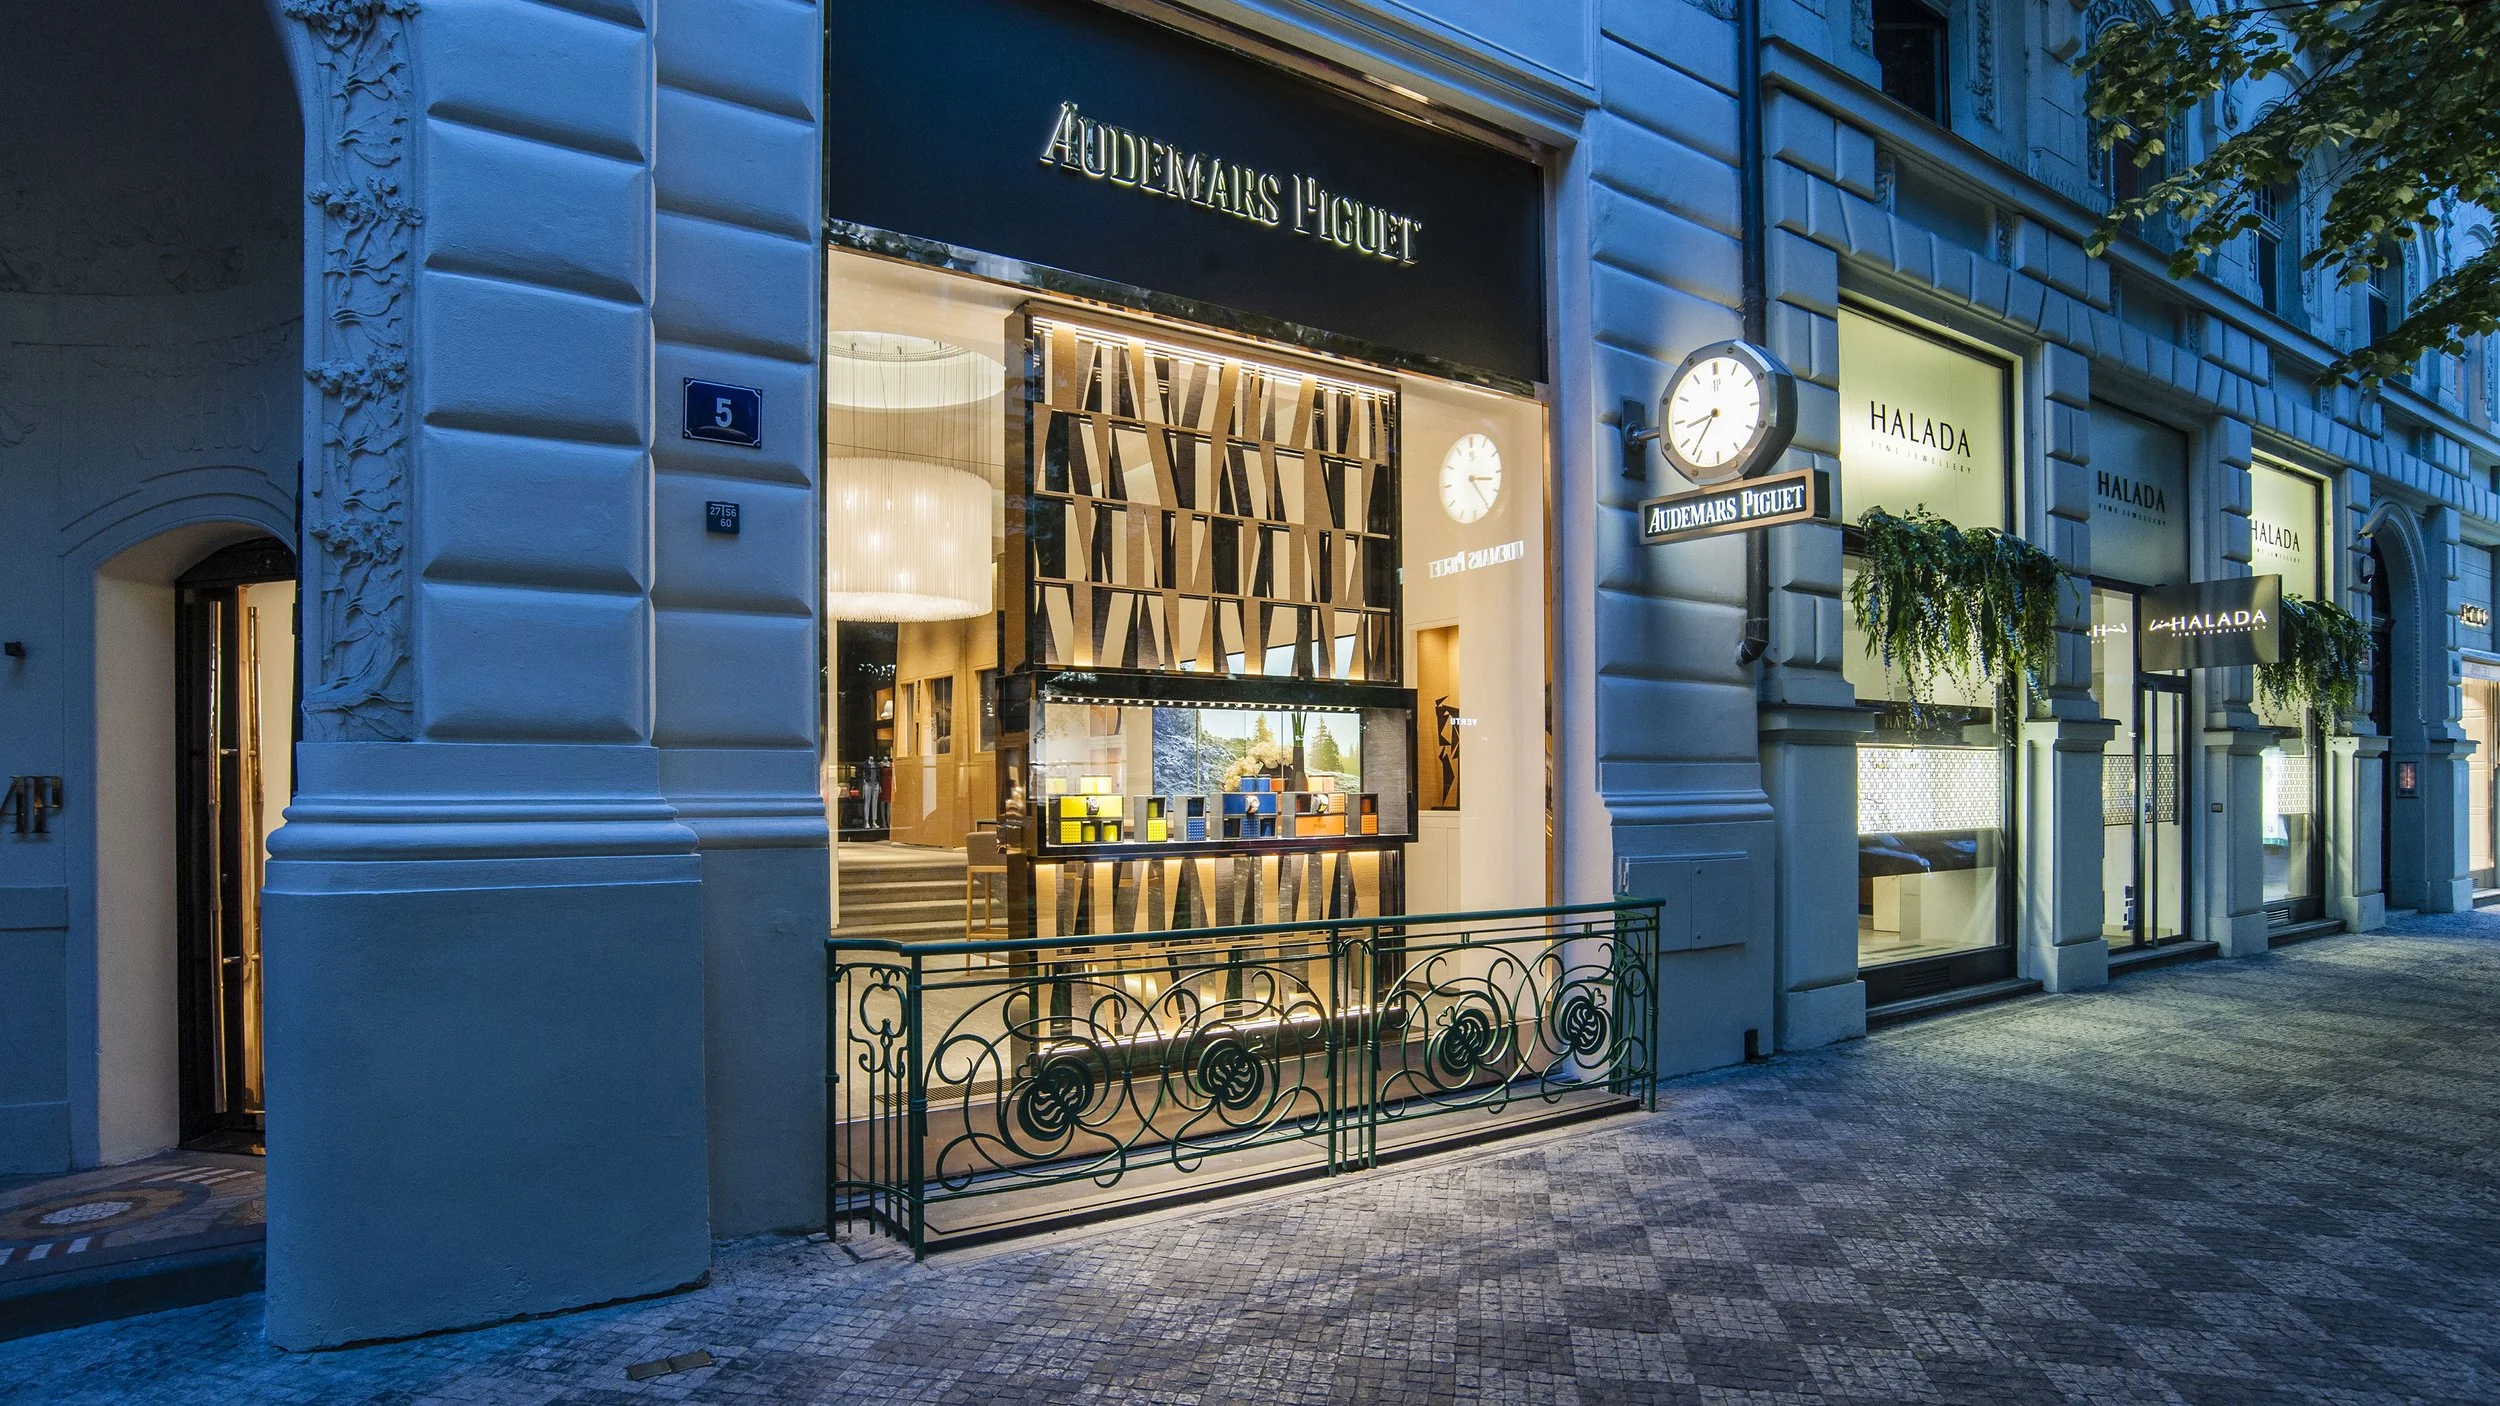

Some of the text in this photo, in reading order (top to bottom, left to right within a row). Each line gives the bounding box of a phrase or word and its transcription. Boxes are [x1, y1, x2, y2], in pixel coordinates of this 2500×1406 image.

[1039, 100, 1424, 266] AUDEMARS PIGUET
[714, 397, 733, 428] 5
[1870, 400, 1971, 458] HALADA
[1907, 450, 1972, 475] JEWELLERY
[1647, 484, 1806, 534] AUDEMARS PIGUET
[2097, 470, 2166, 514] HALADA
[720, 518, 732, 528] 60
[2171, 608, 2268, 631] HALADA
